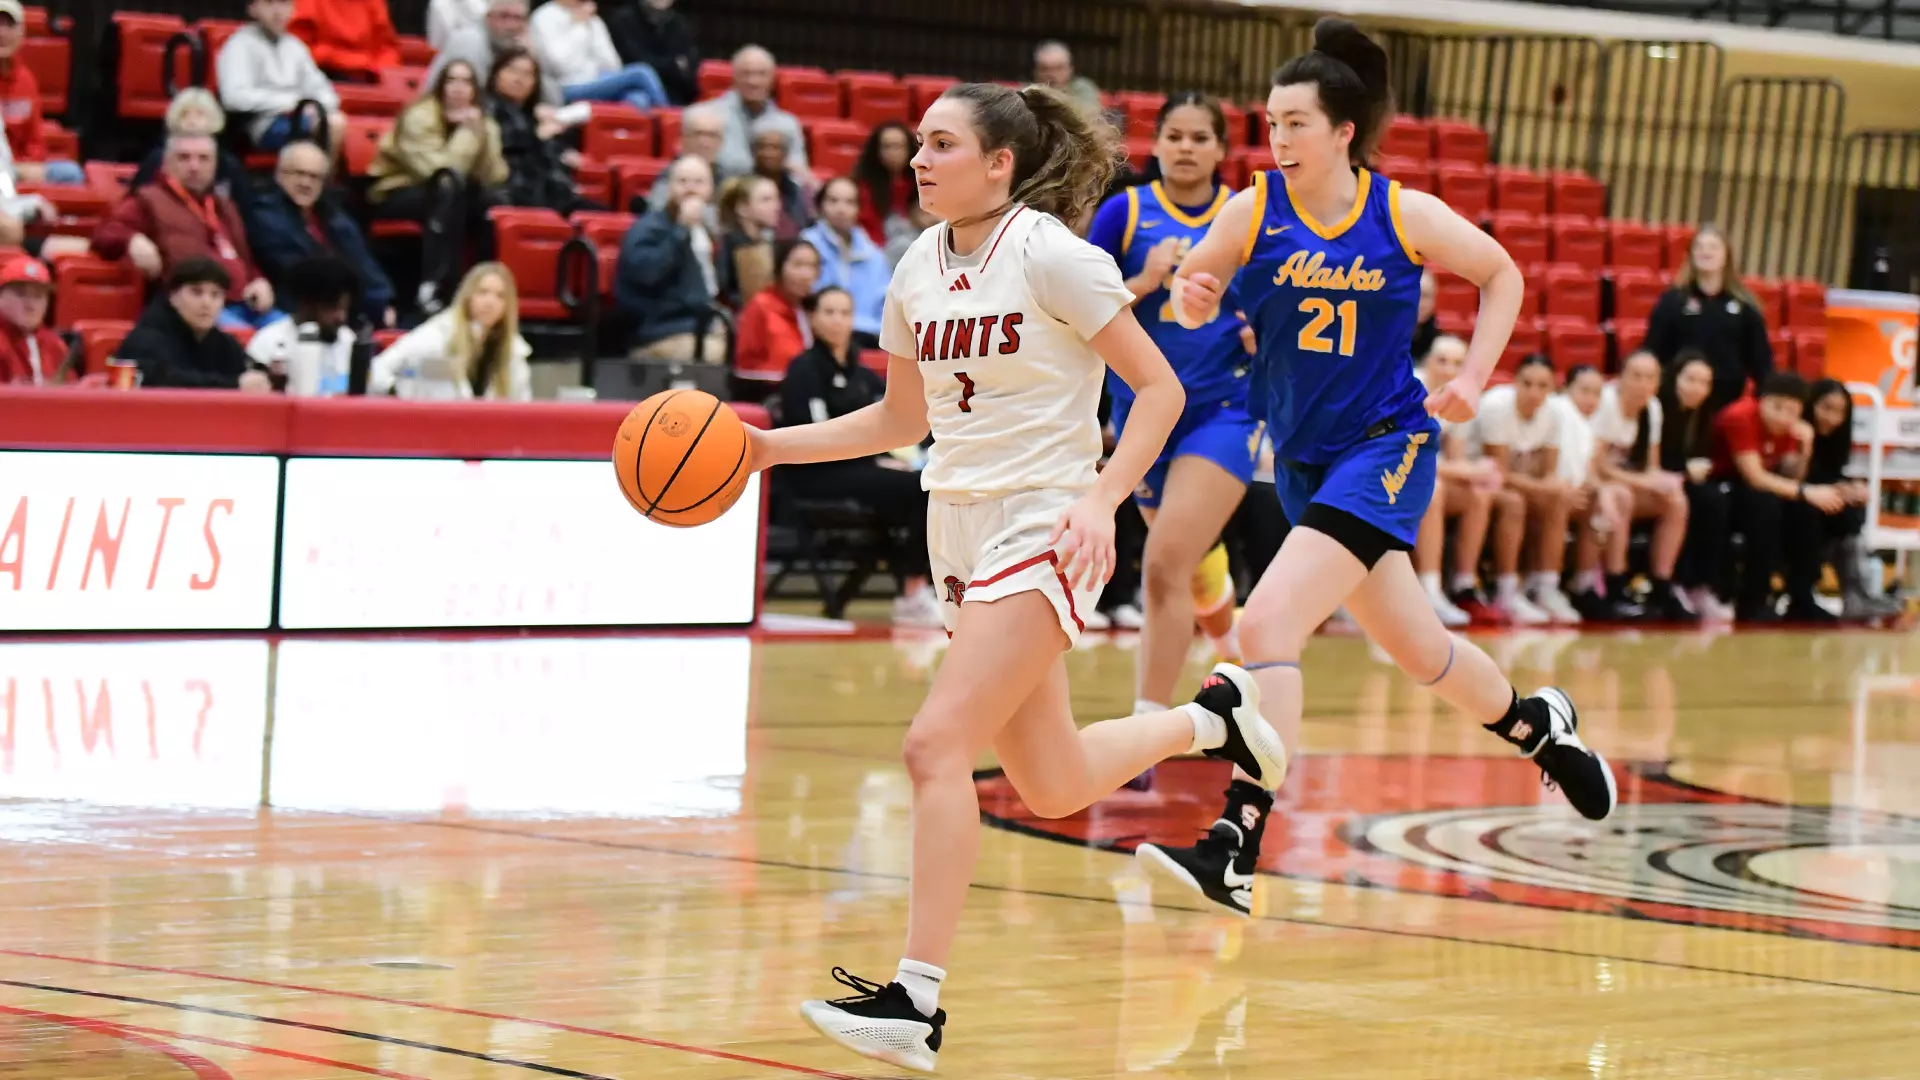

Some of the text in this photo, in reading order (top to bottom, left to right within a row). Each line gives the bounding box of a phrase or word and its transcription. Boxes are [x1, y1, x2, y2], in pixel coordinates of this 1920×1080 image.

[1272, 249, 1387, 292] Alaska
[1297, 297, 1358, 357] 21
[953, 371, 976, 413] 1
